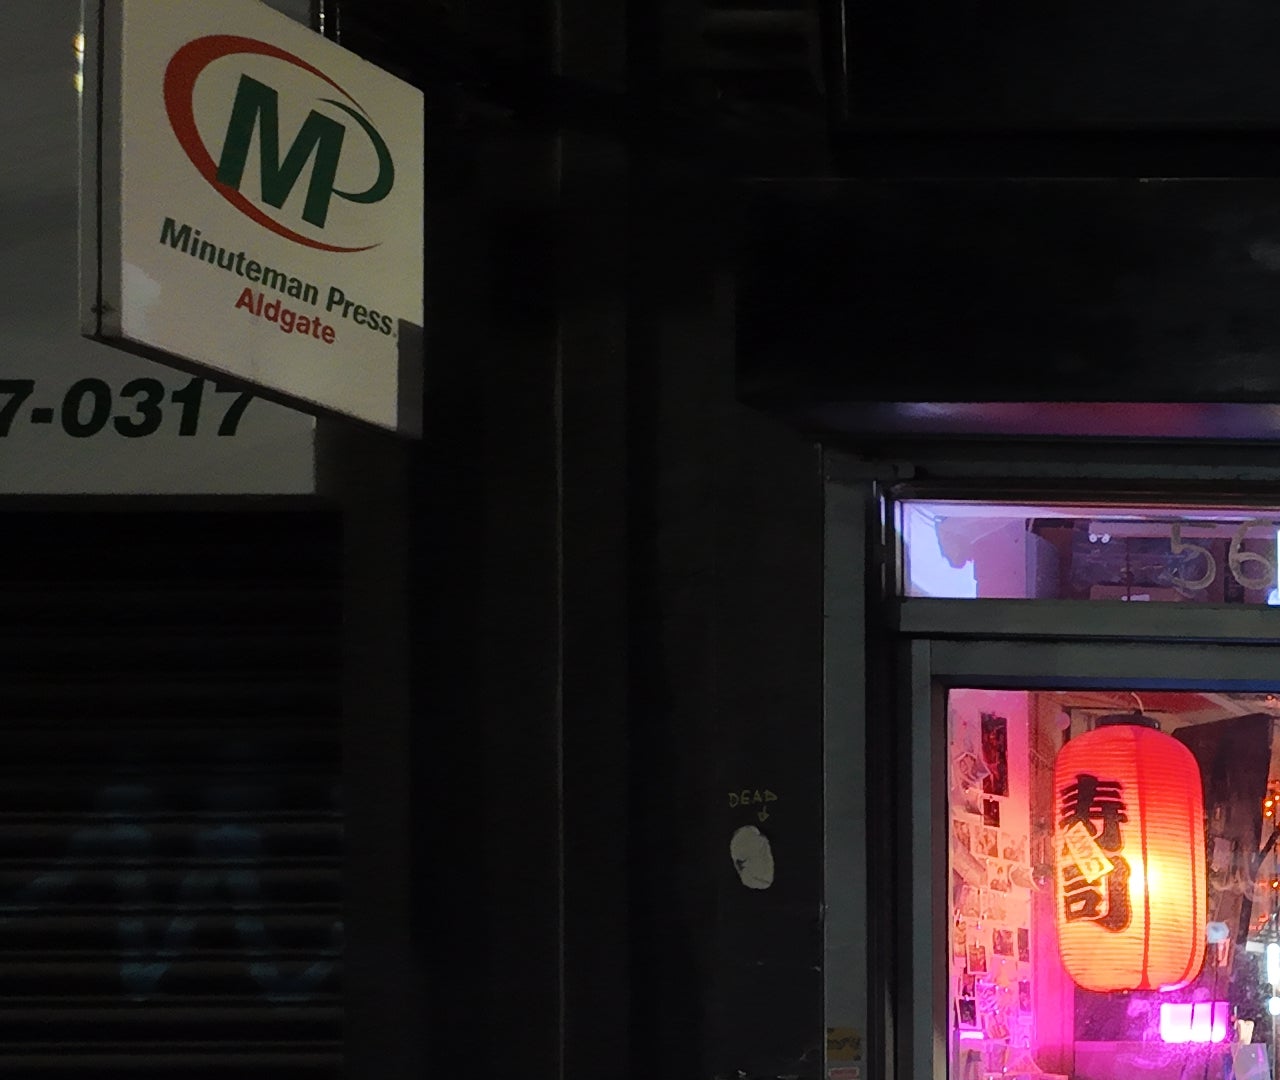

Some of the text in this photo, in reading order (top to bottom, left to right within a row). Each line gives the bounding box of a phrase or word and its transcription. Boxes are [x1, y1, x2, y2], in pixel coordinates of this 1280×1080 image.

[159, 217, 319, 306] Minuteman
[235, 287, 337, 345] Aldgate
[1169, 518, 1275, 590] 56
[728, 789, 779, 808] DEAD
